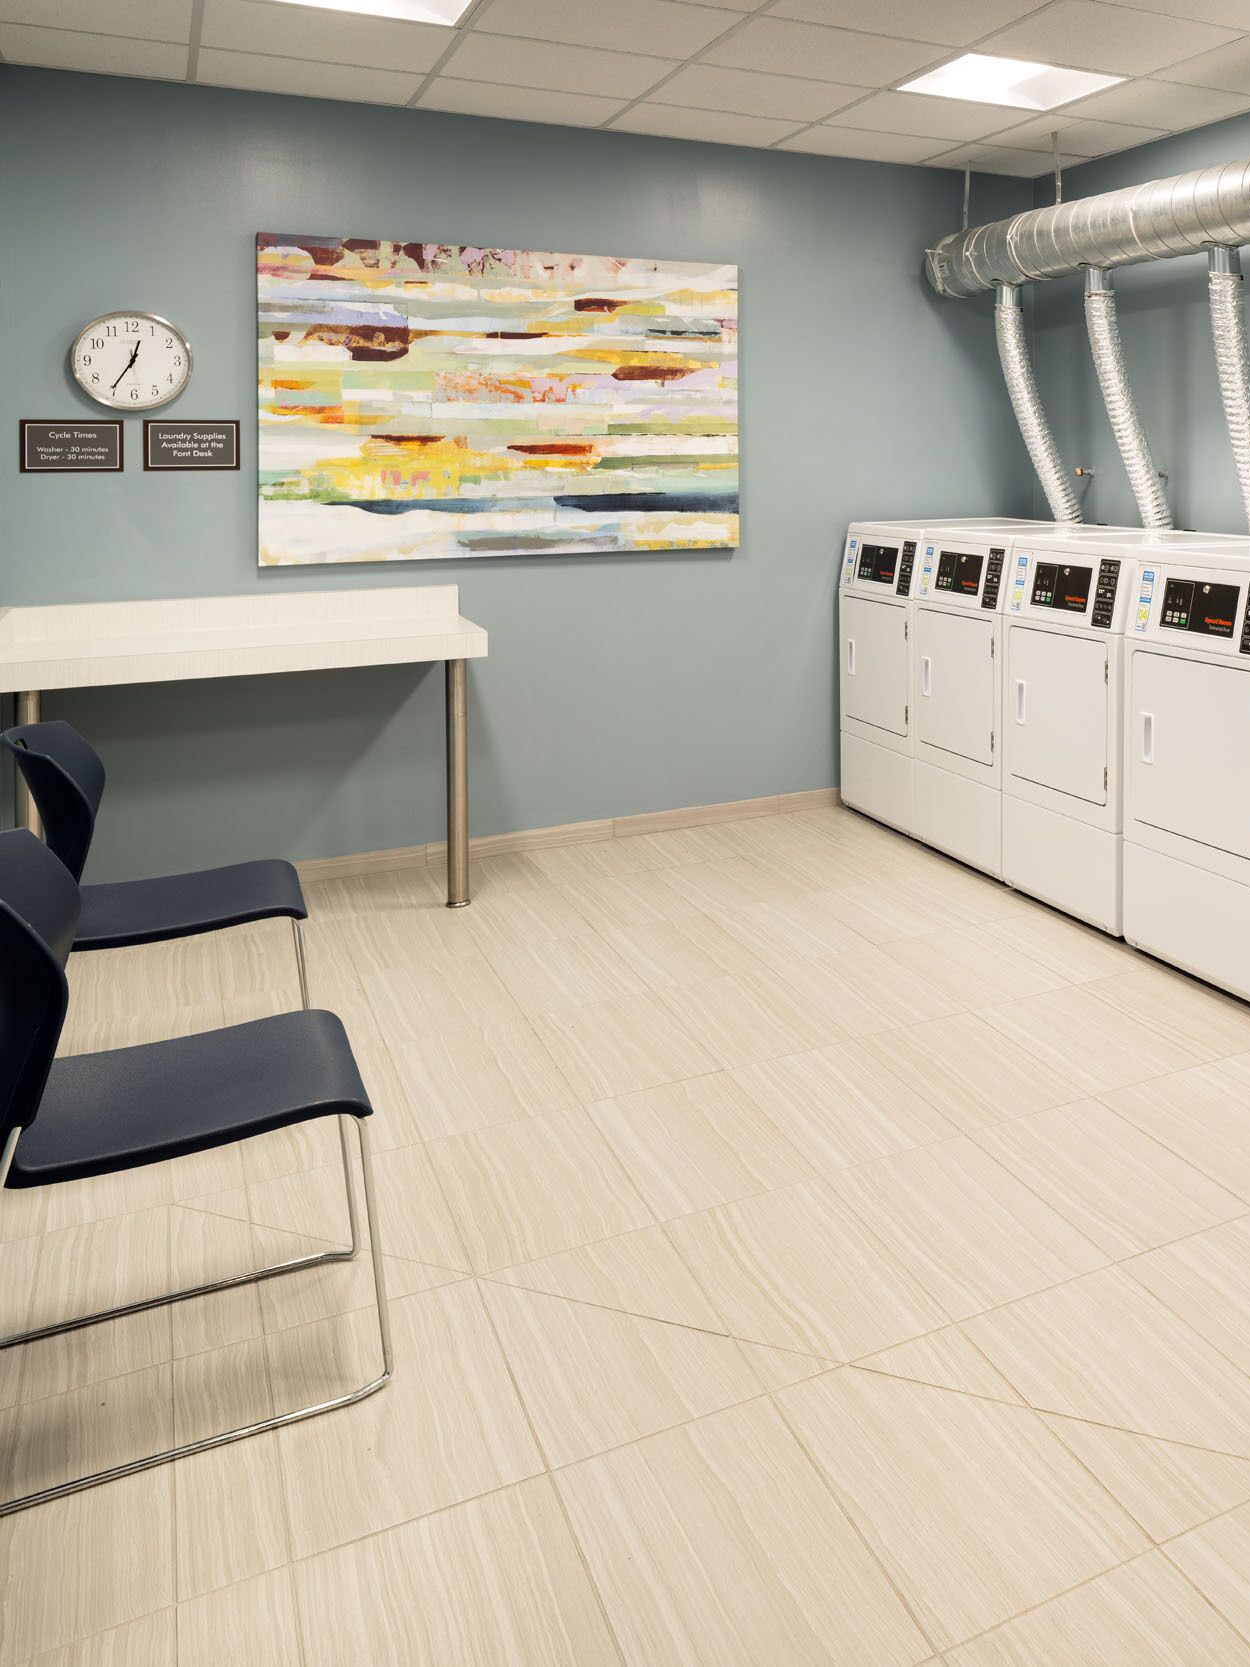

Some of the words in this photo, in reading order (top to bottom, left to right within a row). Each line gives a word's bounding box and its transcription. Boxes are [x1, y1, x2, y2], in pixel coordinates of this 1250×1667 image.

[106, 325, 118, 337] 11
[124, 321, 139, 333] 12
[150, 325, 155, 337] 1
[91, 338, 104, 350] 10
[165, 337, 173, 349] 2
[83, 354, 92, 366] 9
[173, 355, 181, 366] 3
[91, 372, 100, 384] 8
[166, 373, 173, 384] 4
[130, 388, 139, 400] 6
[151, 385, 159, 396] 5
[48, 431, 72, 440] Cycle
[73, 431, 97, 439] Times
[158, 432, 192, 441] Laundry
[193, 432, 227, 441] Supplies
[161, 441, 199, 449] Available
[210, 441, 224, 449] the
[40, 453, 60, 461] Dryer
